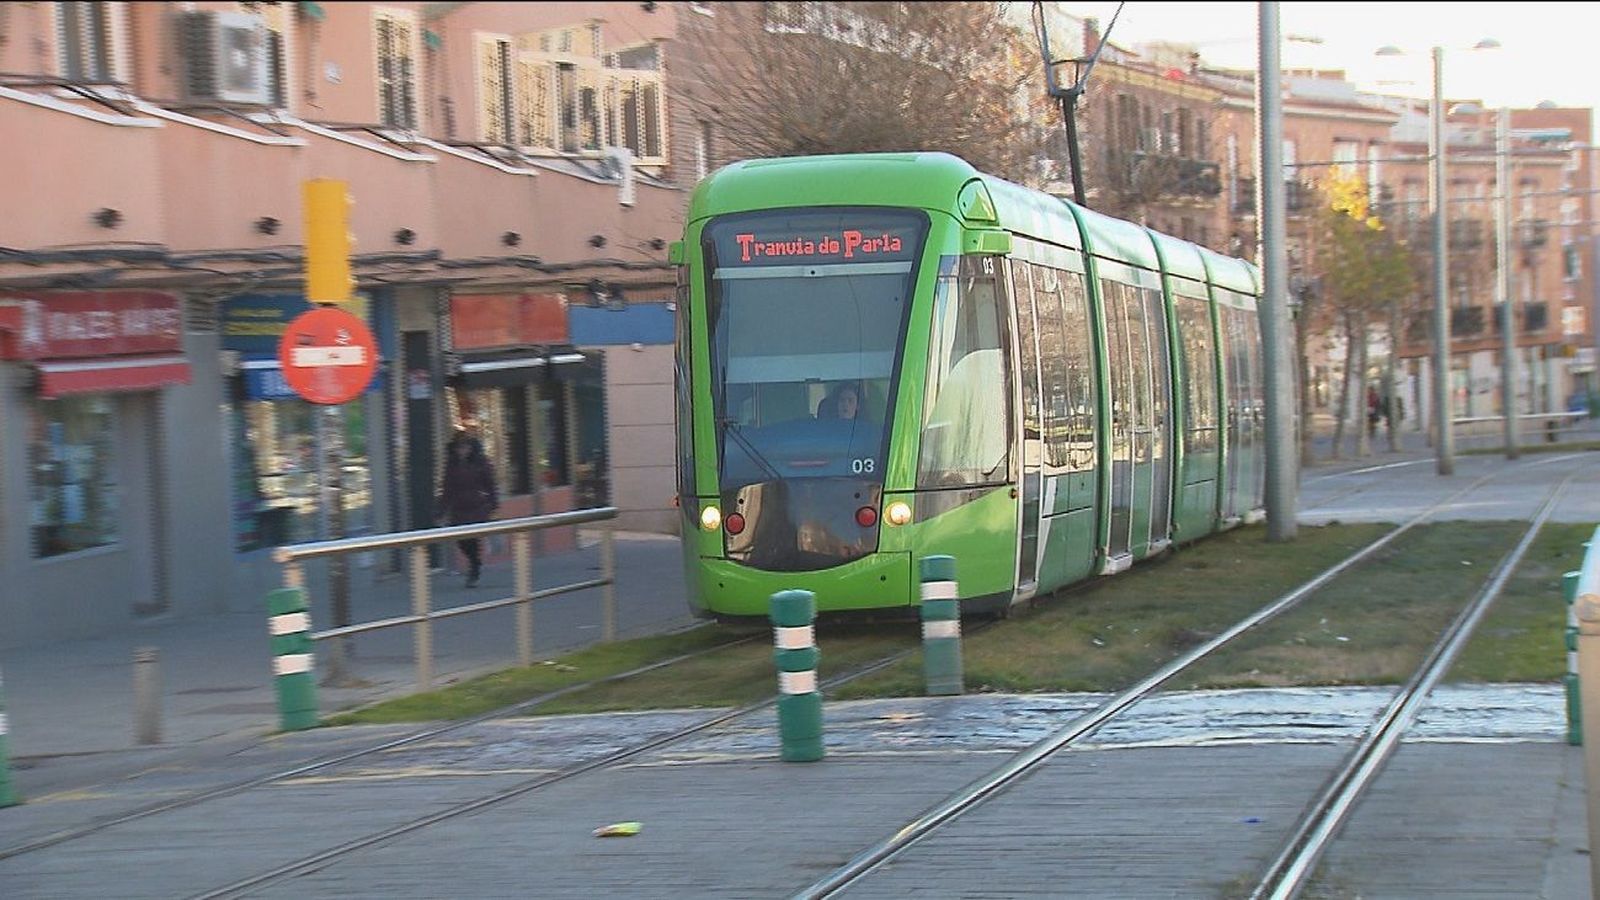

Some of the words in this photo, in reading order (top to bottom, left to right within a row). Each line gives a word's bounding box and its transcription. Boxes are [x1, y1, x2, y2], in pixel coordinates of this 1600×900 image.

[843, 230, 902, 258] Parla
[982, 256, 994, 275] 03
[851, 458, 875, 474] 03
